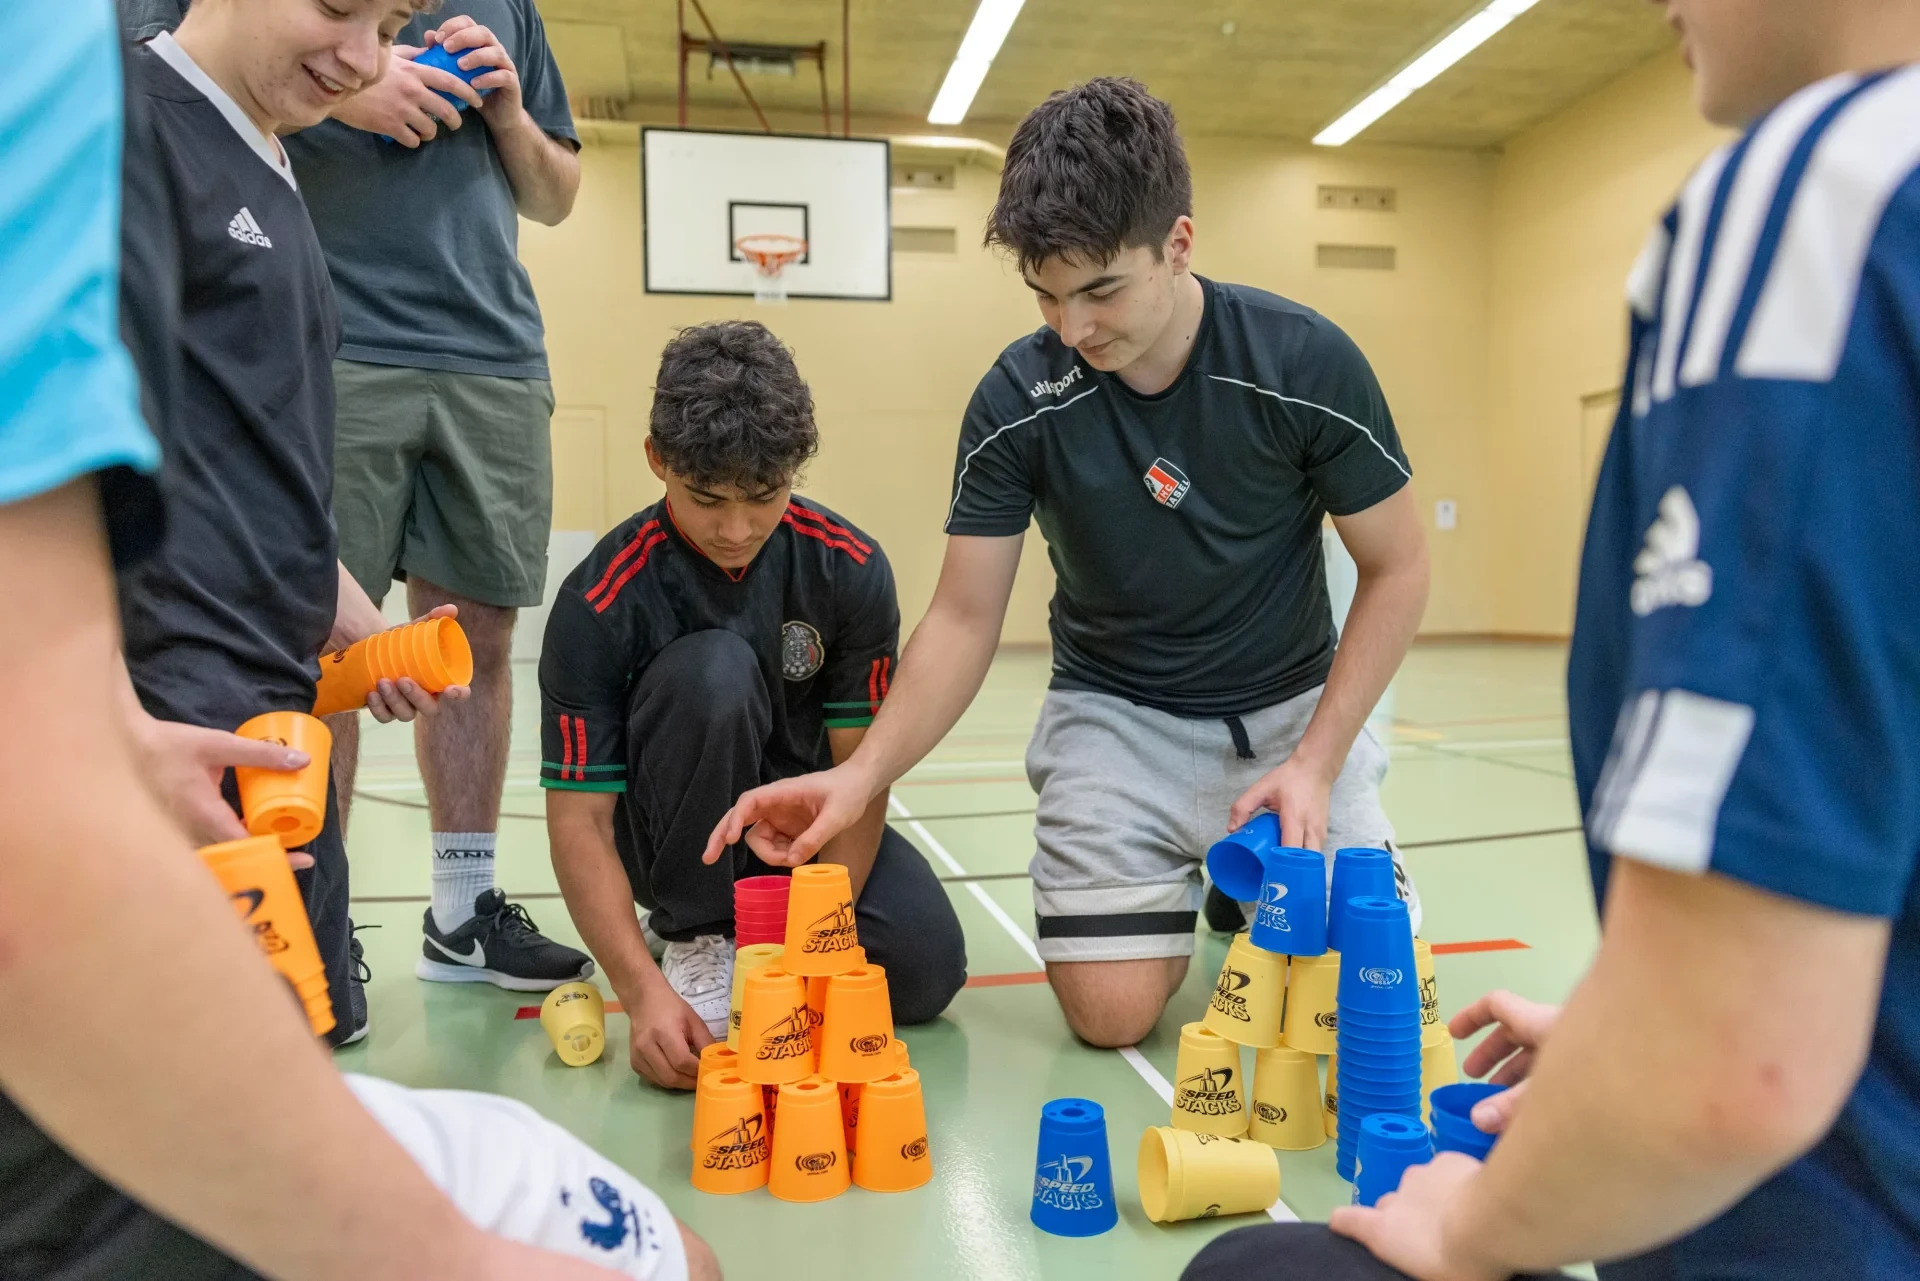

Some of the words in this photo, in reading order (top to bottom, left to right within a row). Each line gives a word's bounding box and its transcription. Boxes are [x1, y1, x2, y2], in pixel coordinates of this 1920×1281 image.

[228, 227, 272, 248] adidas
[1030, 365, 1083, 397] uhlsport
[435, 849, 495, 859] VANS
[817, 923, 856, 938] SPEE
[802, 932, 858, 953] STACK
[772, 1026, 812, 1044] SPEE
[756, 1036, 813, 1060] STACK
[1176, 1093, 1241, 1116] STACKS
[1186, 1089, 1235, 1101] SPEED
[717, 1135, 765, 1155] SPEED
[703, 1146, 769, 1171] STACKS
[1040, 1177, 1095, 1193] SPEED
